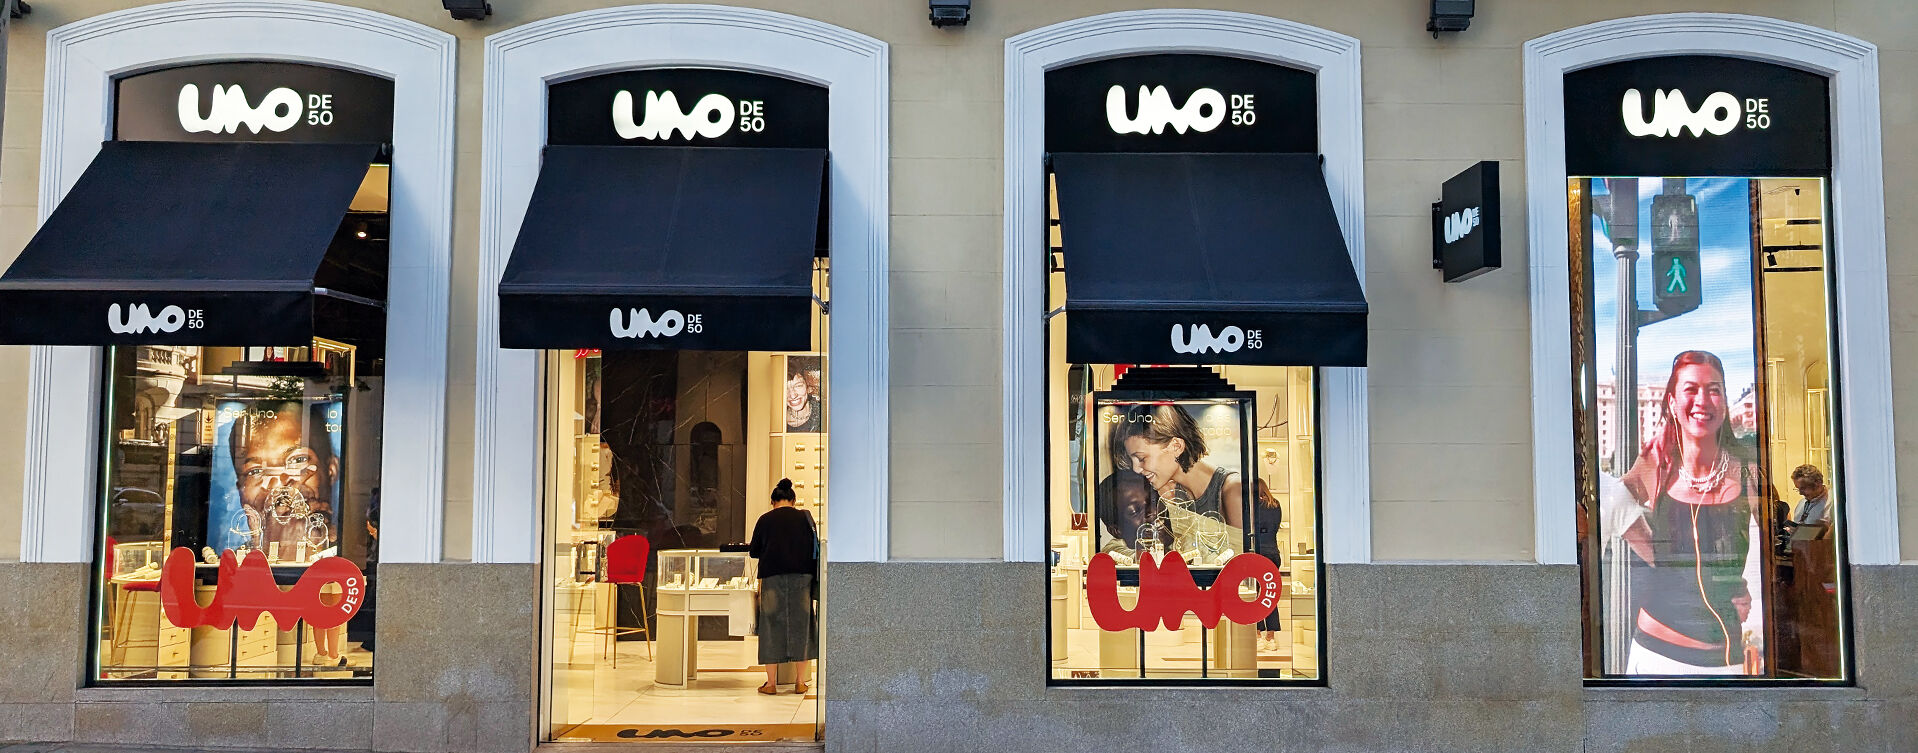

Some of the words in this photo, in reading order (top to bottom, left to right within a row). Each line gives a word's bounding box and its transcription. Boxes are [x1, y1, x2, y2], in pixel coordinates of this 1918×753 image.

[178, 83, 303, 135] UNO
[309, 94, 333, 109] DE
[740, 101, 764, 116] DE
[1232, 95, 1255, 110] DE
[1746, 99, 1769, 113] DE
[612, 89, 735, 140] UNO
[1106, 85, 1226, 135] UNO
[1622, 89, 1741, 138] UNO
[308, 111, 333, 126] 50
[740, 117, 765, 132] 50
[1231, 110, 1256, 126] 50
[1746, 114, 1771, 129] 50
[1444, 207, 1473, 244] UNO
[108, 303, 186, 335] UNO
[188, 309, 203, 319] DE
[688, 314, 702, 323] DE
[188, 319, 204, 329] 50
[609, 307, 684, 339] UNO
[688, 324, 703, 333] 50
[1171, 323, 1245, 354] UNO
[1248, 329, 1262, 339] DE
[1248, 339, 1262, 349] 50
[1102, 412, 1125, 423] Ser
[1128, 412, 1156, 425] Uno,
[161, 546, 366, 632] UNO
[341, 577, 359, 614] DE50
[1086, 551, 1282, 632] UNO
[1261, 572, 1277, 608] DE50
